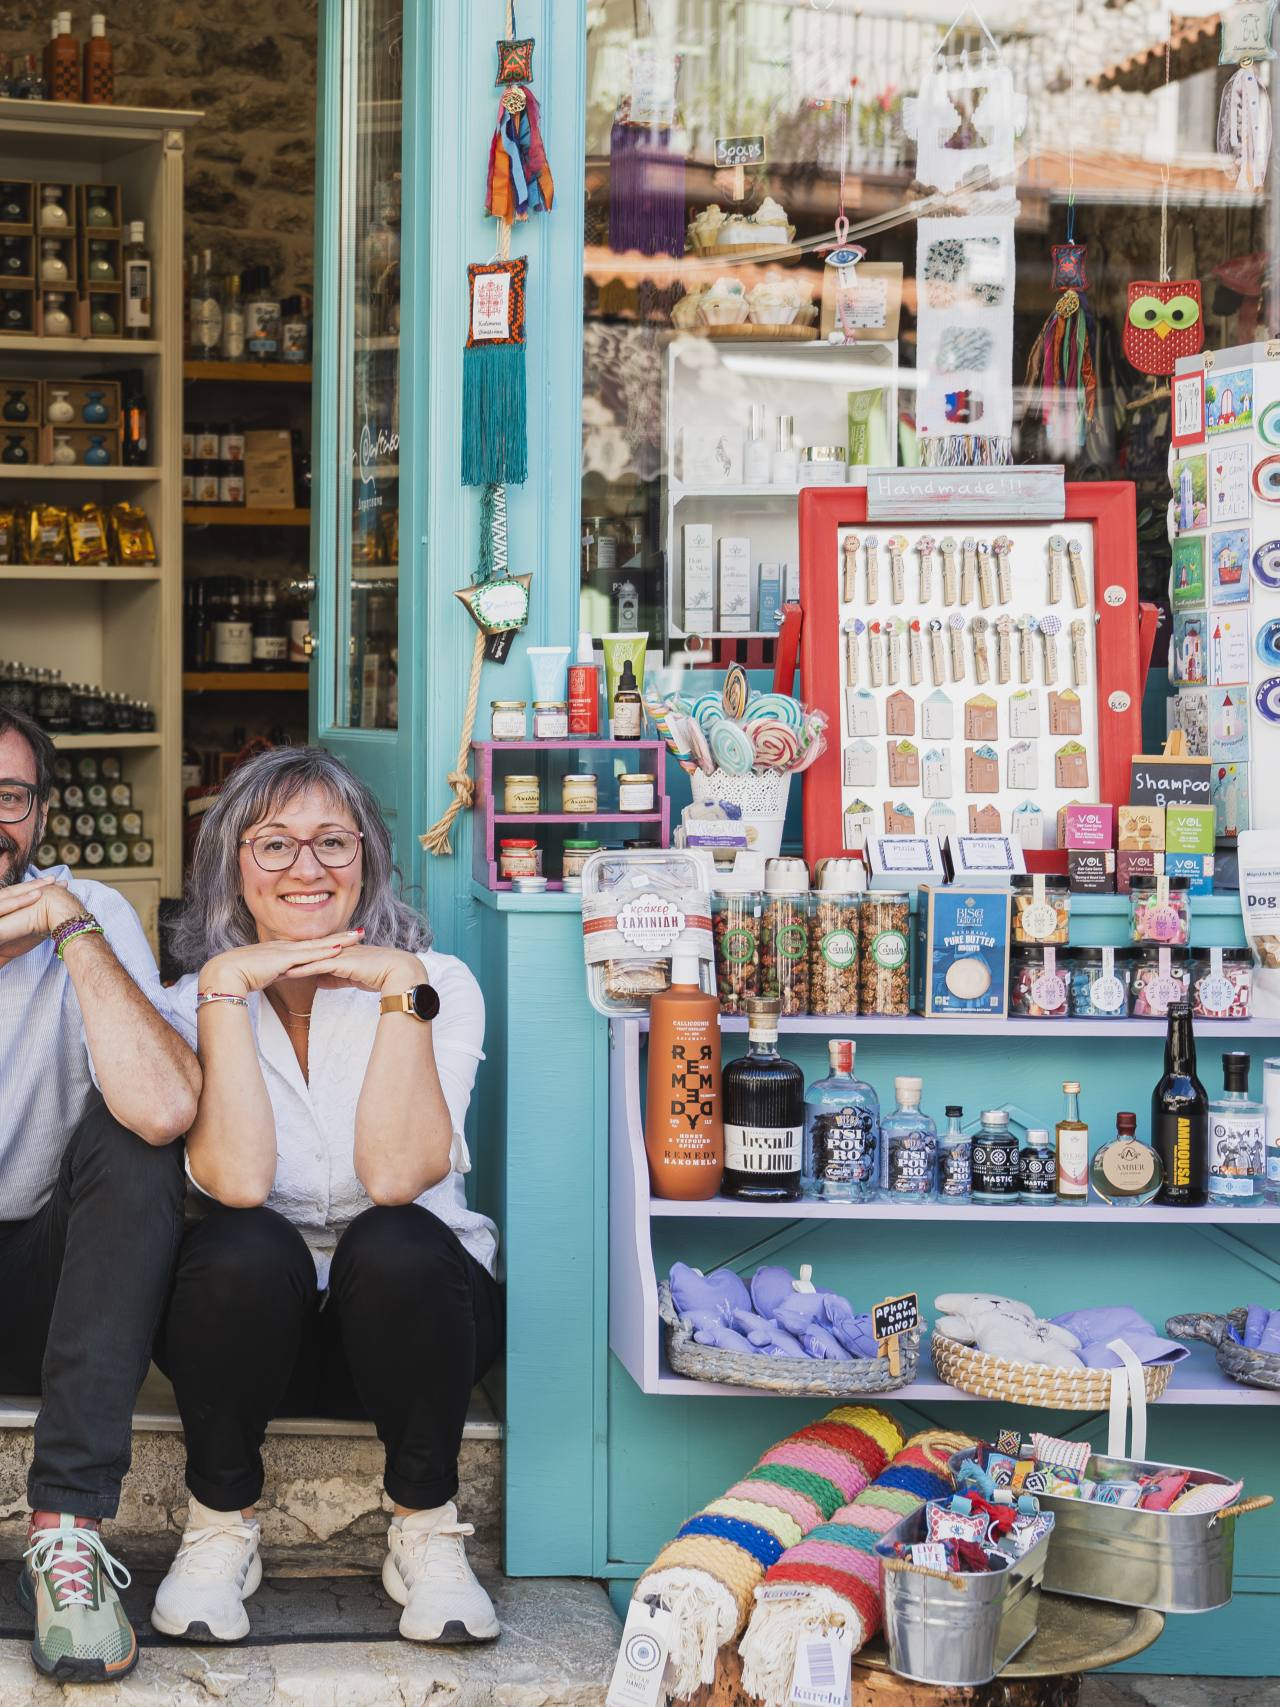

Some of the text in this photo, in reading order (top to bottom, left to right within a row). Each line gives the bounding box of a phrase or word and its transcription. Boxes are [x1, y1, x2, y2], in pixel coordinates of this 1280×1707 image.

[717, 140, 762, 159] Soaps
[878, 477, 1022, 497] Handmade!!!
[1135, 772, 1211, 796] Shampoo
[1247, 895, 1277, 909] Dog
[621, 916, 679, 929] ΣΑΧΙΝΙΔΗ
[943, 934, 996, 948] PURE BUTTER
[827, 941, 853, 956] Candy
[877, 941, 904, 956] Candy
[829, 1129, 863, 1140] TSI
[827, 1139, 865, 1150] POU
[663, 1149, 717, 1159] REMEDY
[832, 1149, 861, 1161] RO
[900, 1150, 927, 1159] TSI
[1177, 1117, 1190, 1186] AMMOUSA
[663, 1158, 717, 1167] RAKOMELO
[897, 1158, 928, 1168] POU
[1116, 1163, 1145, 1171] AMBER
[902, 1167, 925, 1176] RO
[983, 1175, 1013, 1183] MASTIC
[1023, 1179, 1049, 1187] MASTIC
[881, 1317, 915, 1337] ΥΠΝΟΥ
[793, 1686, 849, 1706] kurelu
